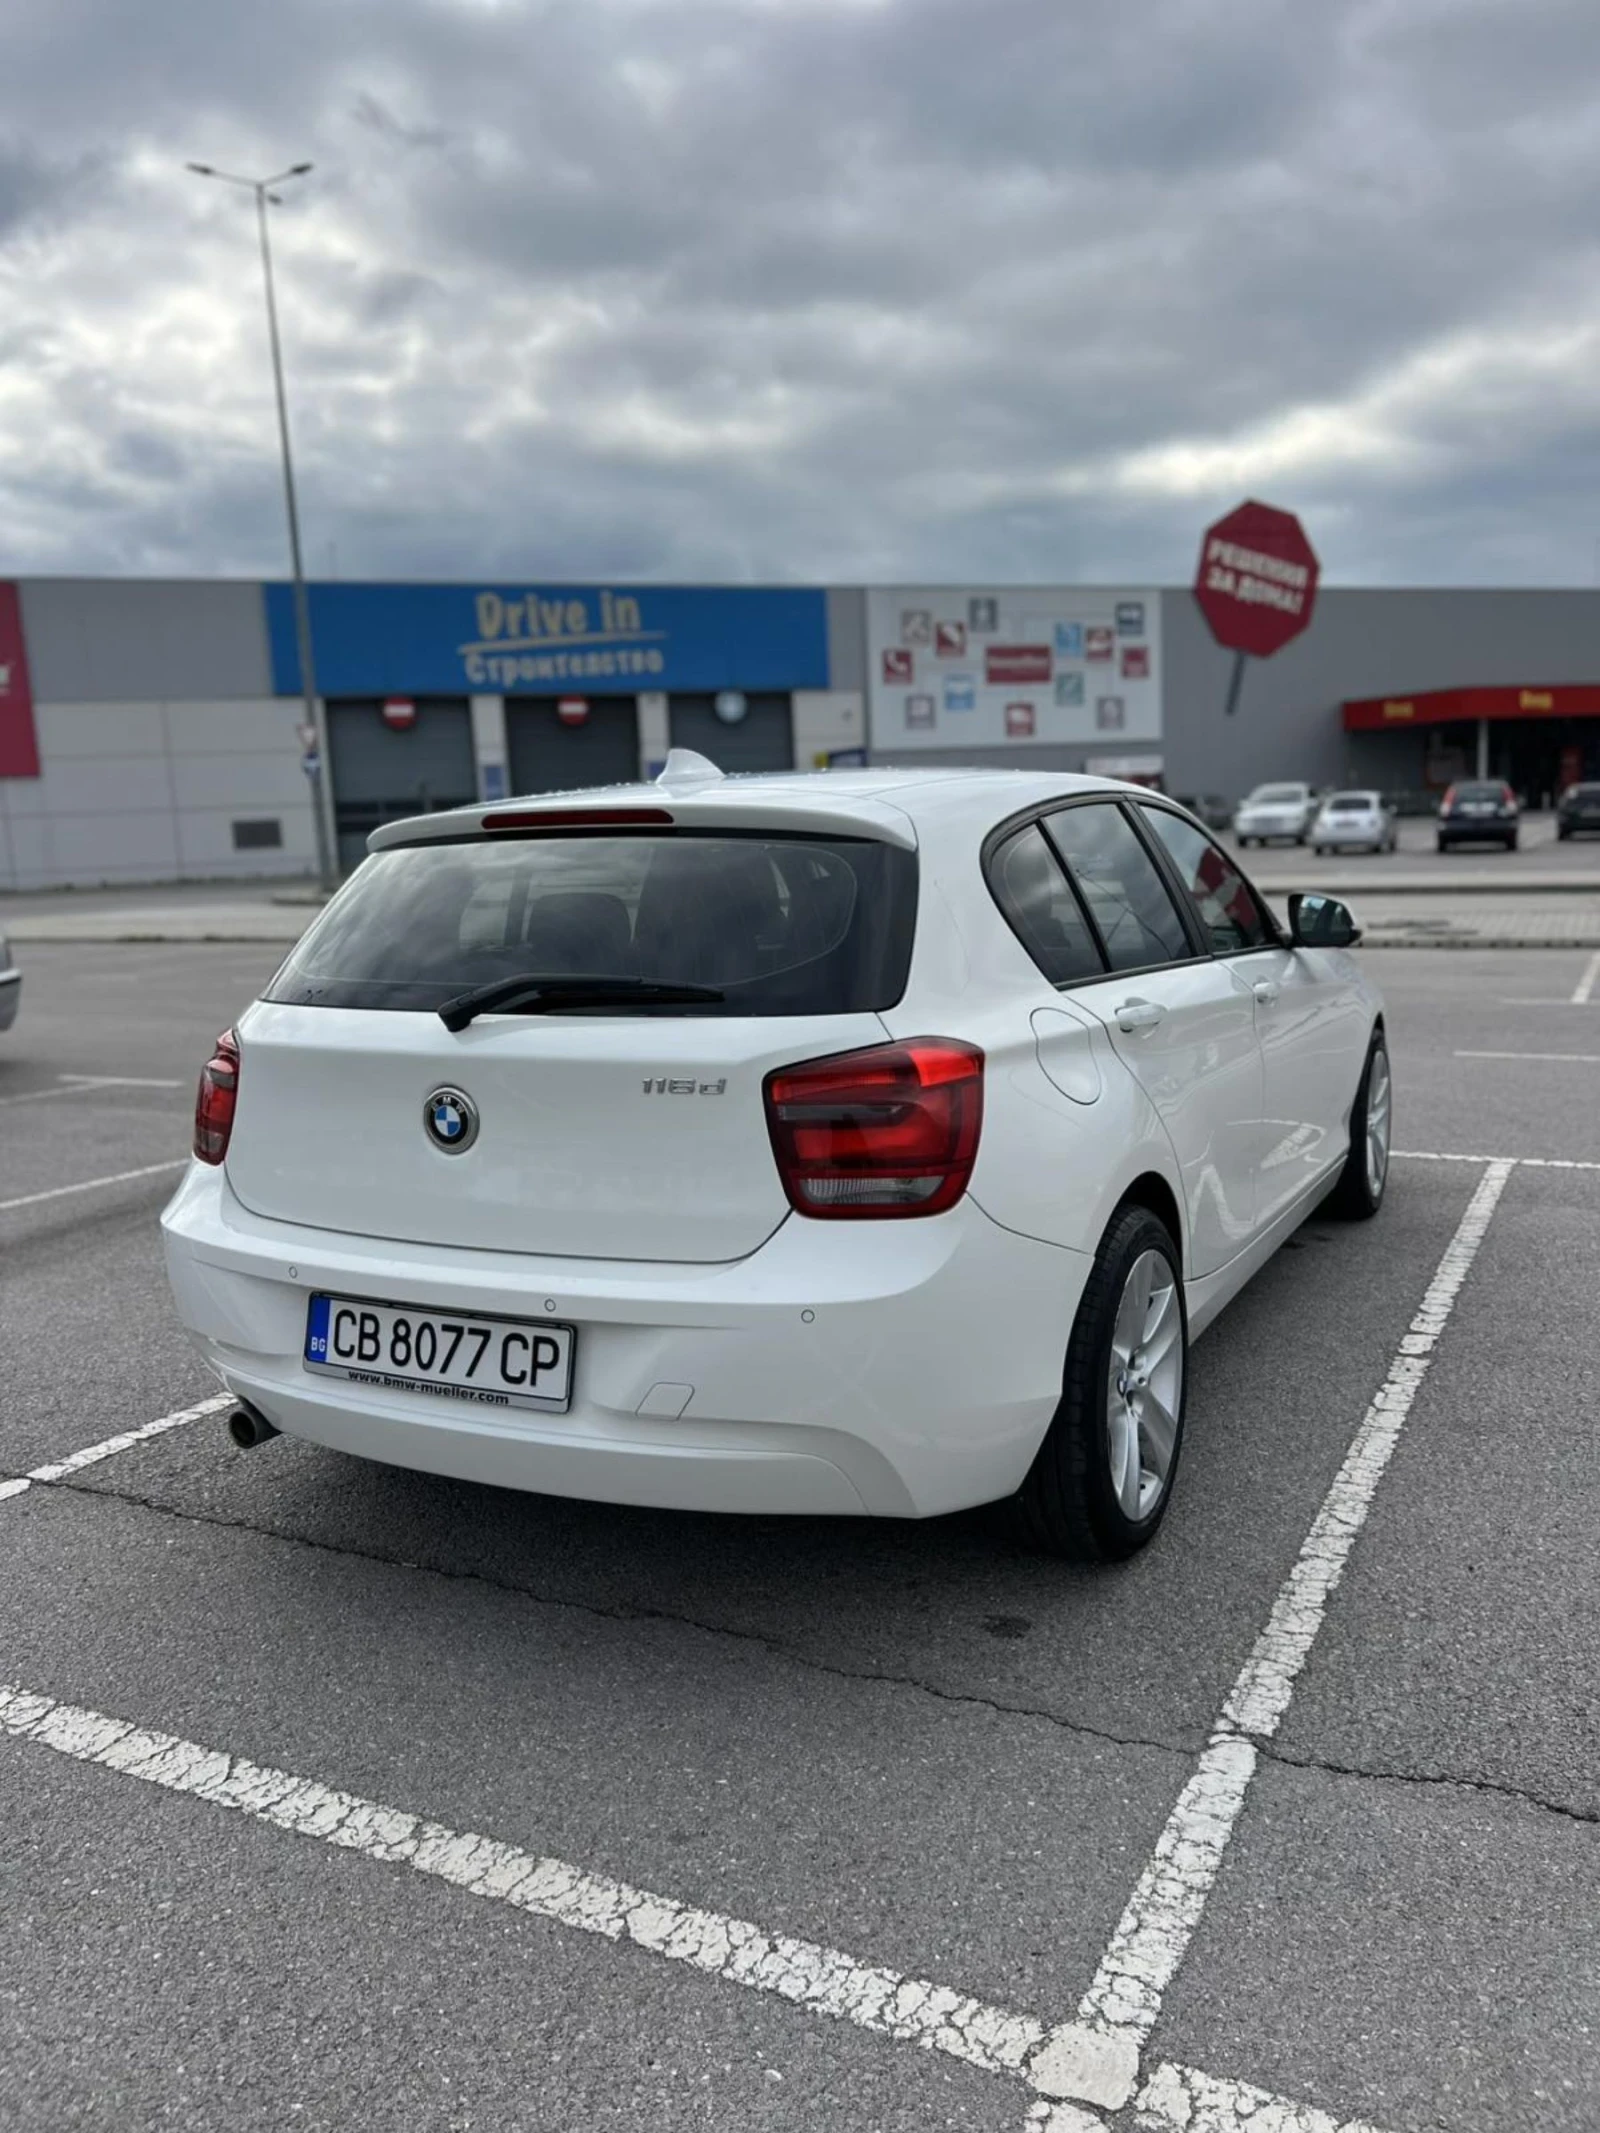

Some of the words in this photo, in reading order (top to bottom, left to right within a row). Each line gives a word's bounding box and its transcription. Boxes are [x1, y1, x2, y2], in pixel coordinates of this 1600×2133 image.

[475, 591, 588, 639] Drive
[600, 589, 641, 632] in
[311, 1336, 326, 1353] BG
[390, 1318, 491, 1377] 8077
[348, 1370, 510, 1405] www.bmw-mueller.com
